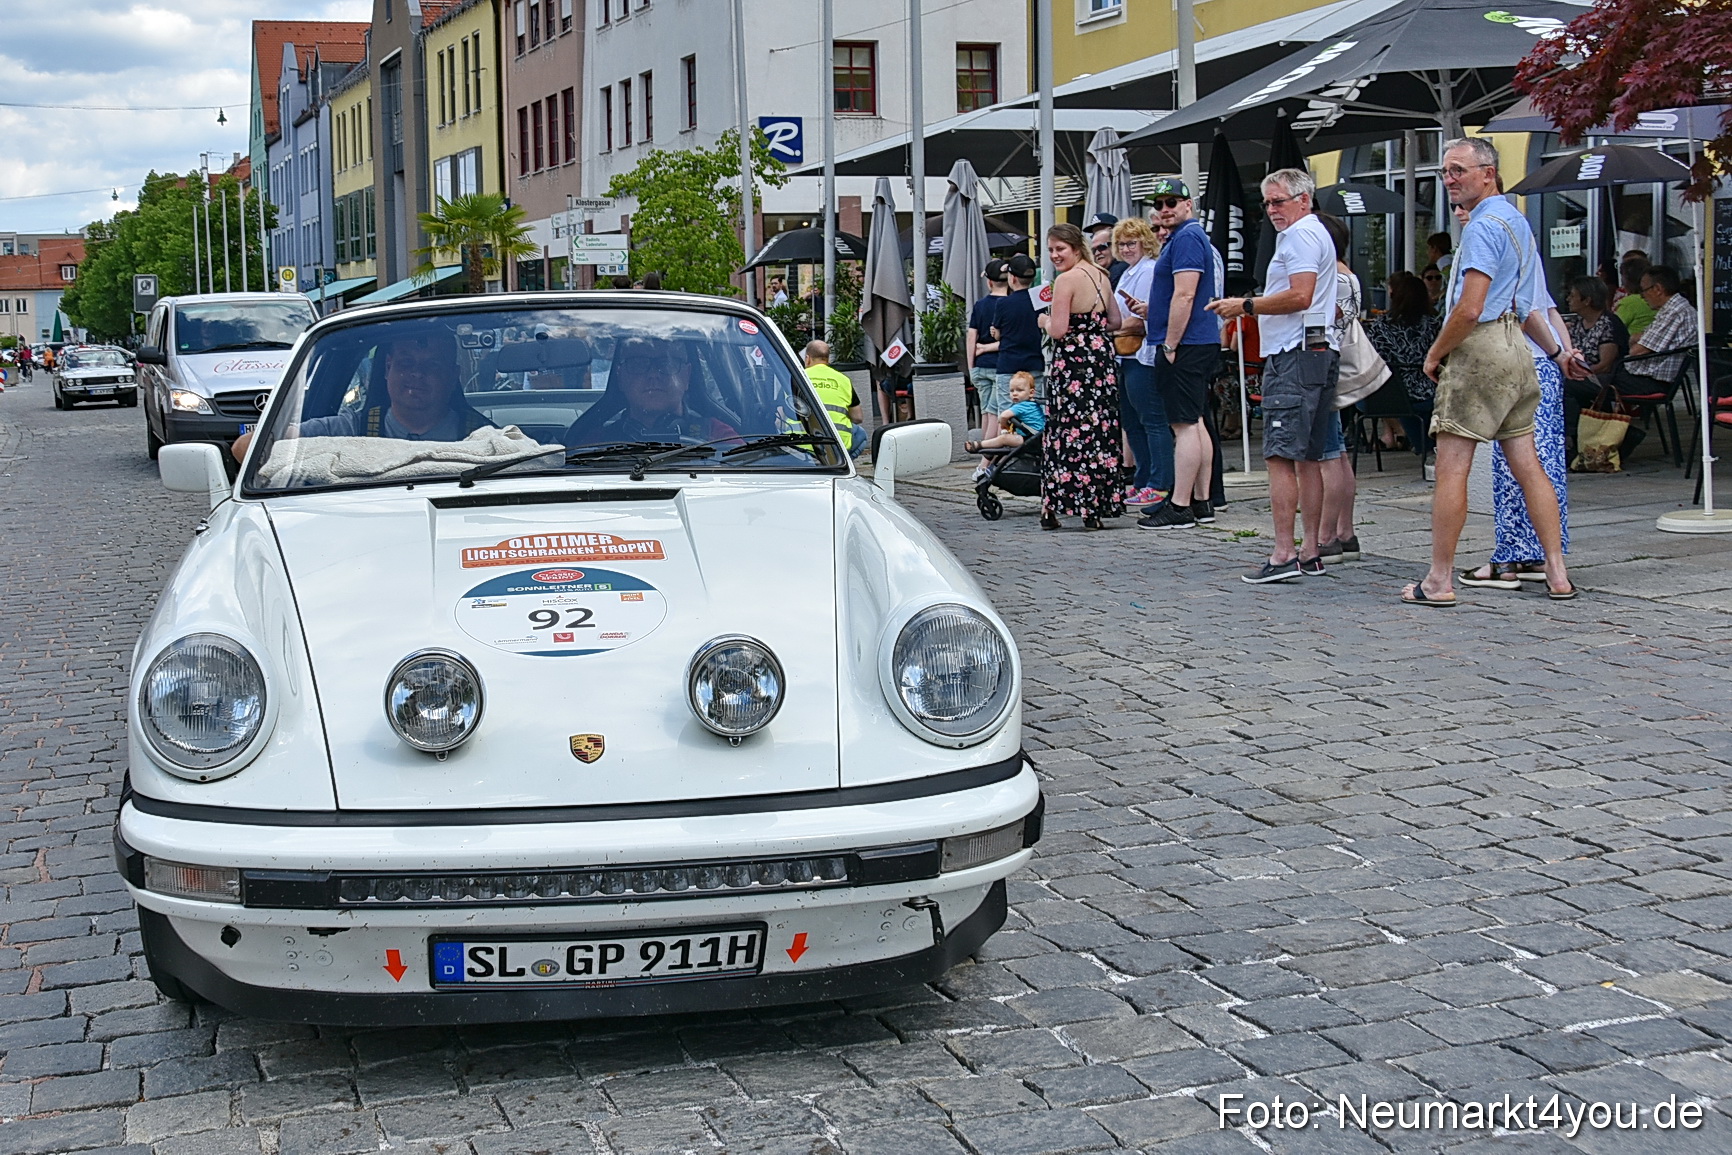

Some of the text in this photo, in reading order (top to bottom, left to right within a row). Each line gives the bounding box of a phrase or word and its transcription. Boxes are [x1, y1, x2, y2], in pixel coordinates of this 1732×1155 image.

[1577, 154, 1606, 180] now
[575, 199, 610, 208] Klostergasse
[1343, 192, 1366, 213] now
[466, 541, 656, 561] LICHTSCHRANKEN-TROPHY
[508, 534, 613, 549] OLDTIMER
[506, 583, 592, 592] SONNLEITNER
[528, 607, 596, 630] 92
[467, 933, 757, 978] SL GP 911H
[443, 965, 455, 975] D
